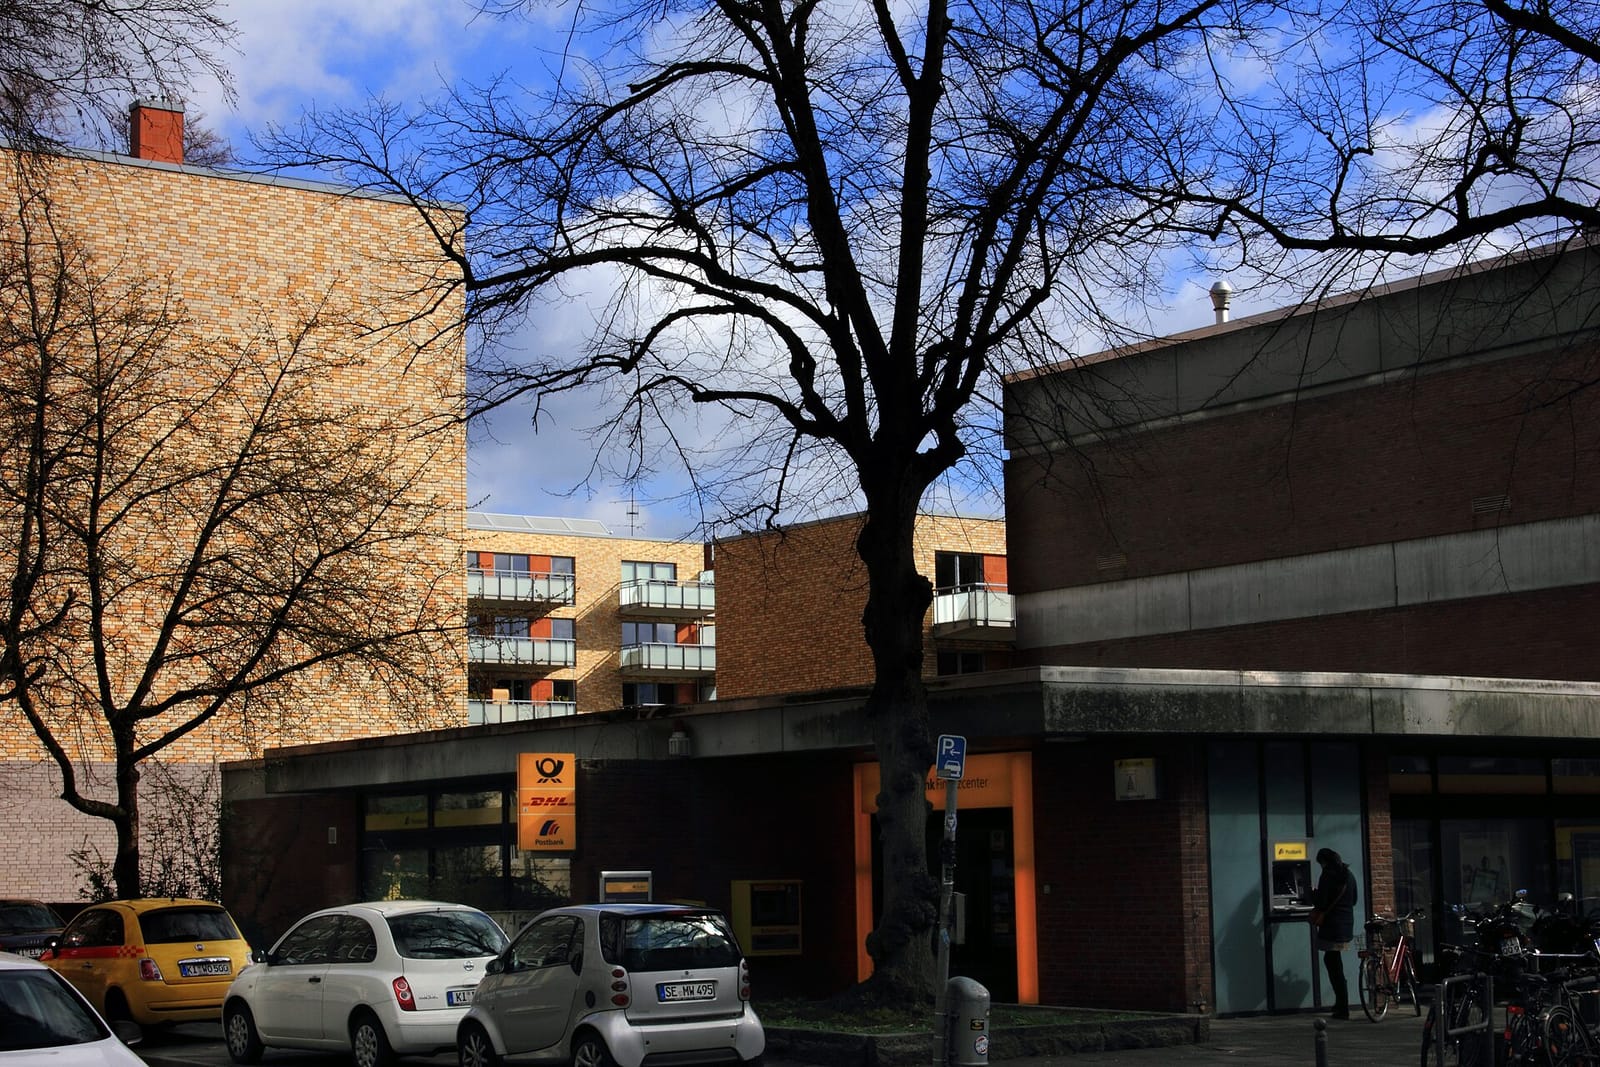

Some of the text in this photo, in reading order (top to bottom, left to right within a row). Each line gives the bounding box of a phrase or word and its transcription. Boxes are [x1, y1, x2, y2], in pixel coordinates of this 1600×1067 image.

[942, 738, 955, 756] P
[530, 797, 569, 806] DHL
[535, 838, 564, 846] Postbank
[665, 984, 713, 997] SE MW 495
[455, 992, 467, 1002] KI
